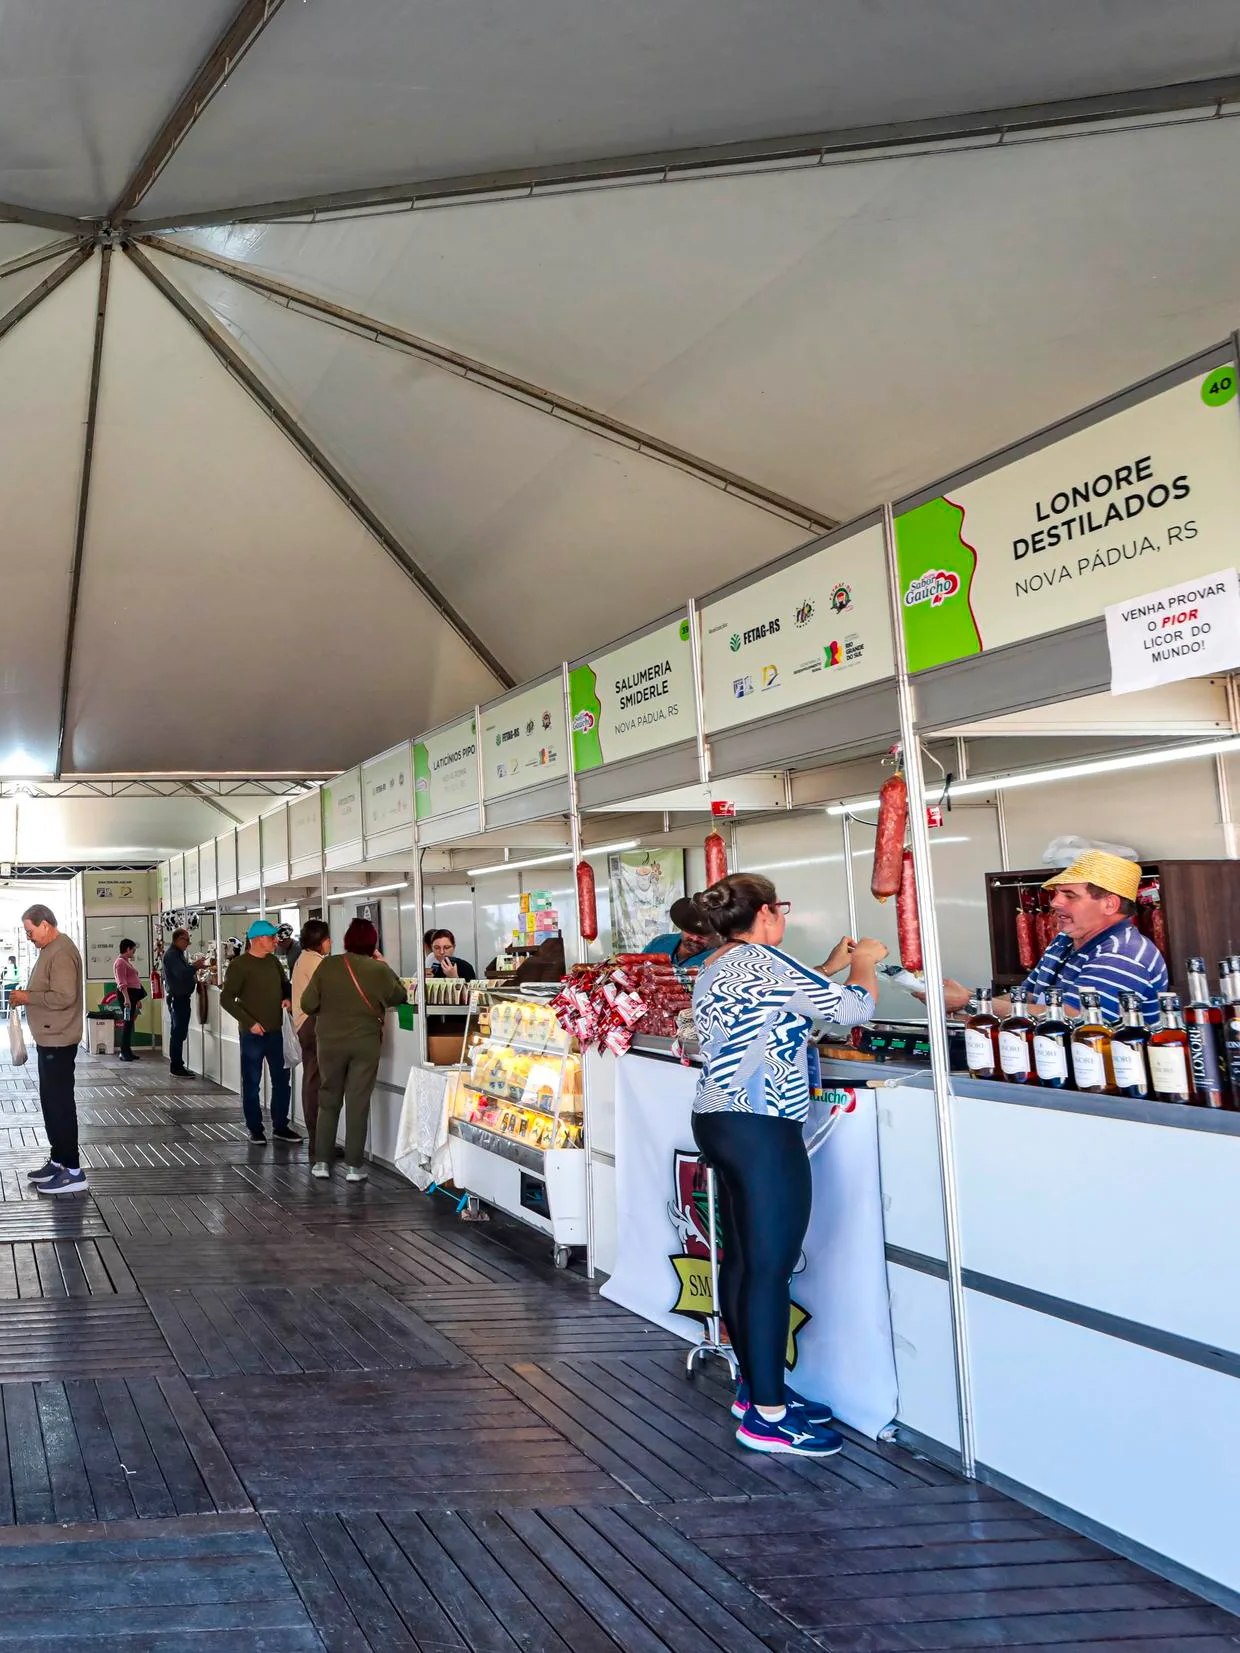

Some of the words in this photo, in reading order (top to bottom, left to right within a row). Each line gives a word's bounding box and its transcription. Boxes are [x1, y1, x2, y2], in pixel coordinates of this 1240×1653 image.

[1209, 377, 1232, 395] 40
[1036, 455, 1153, 522] LONORE
[1013, 475, 1191, 560] DESTILADOS
[1015, 565, 1072, 597] NOVA
[1078, 536, 1161, 575] PÁDUA,
[1167, 520, 1199, 545] RS
[1121, 601, 1165, 622] VENHA
[1168, 583, 1226, 608] PROVAR
[743, 618, 780, 645] FETAG-RS
[1147, 621, 1157, 632] O
[1161, 609, 1198, 628] PIOR
[1143, 631, 1183, 650] LICOR
[1191, 623, 1211, 637] DO
[1152, 640, 1206, 663] MUNDO!
[615, 660, 672, 694] SALUMERIA
[620, 680, 669, 710] SMIDERLE
[614, 721, 635, 735] NOVA
[667, 704, 679, 716] RS
[462, 744, 476, 759] PIPO
[1189, 1025, 1206, 1078] LONORE
[689, 1274, 713, 1298] SM
